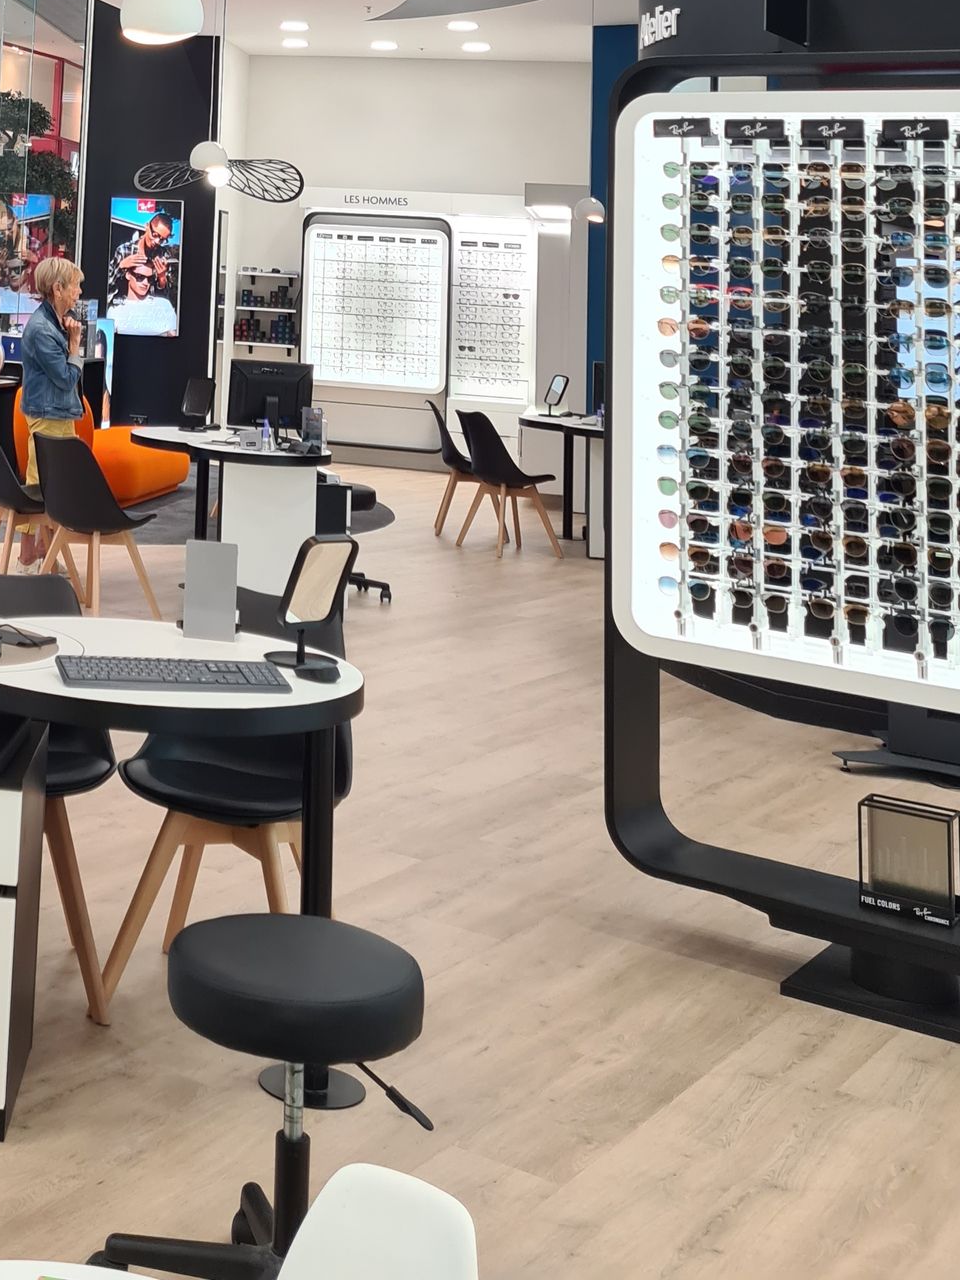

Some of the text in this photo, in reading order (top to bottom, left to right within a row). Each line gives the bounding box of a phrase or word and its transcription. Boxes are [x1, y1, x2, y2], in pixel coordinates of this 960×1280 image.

[344, 195, 408, 207] LES HOMMES
[861, 896, 900, 911] FUEL COLORS
